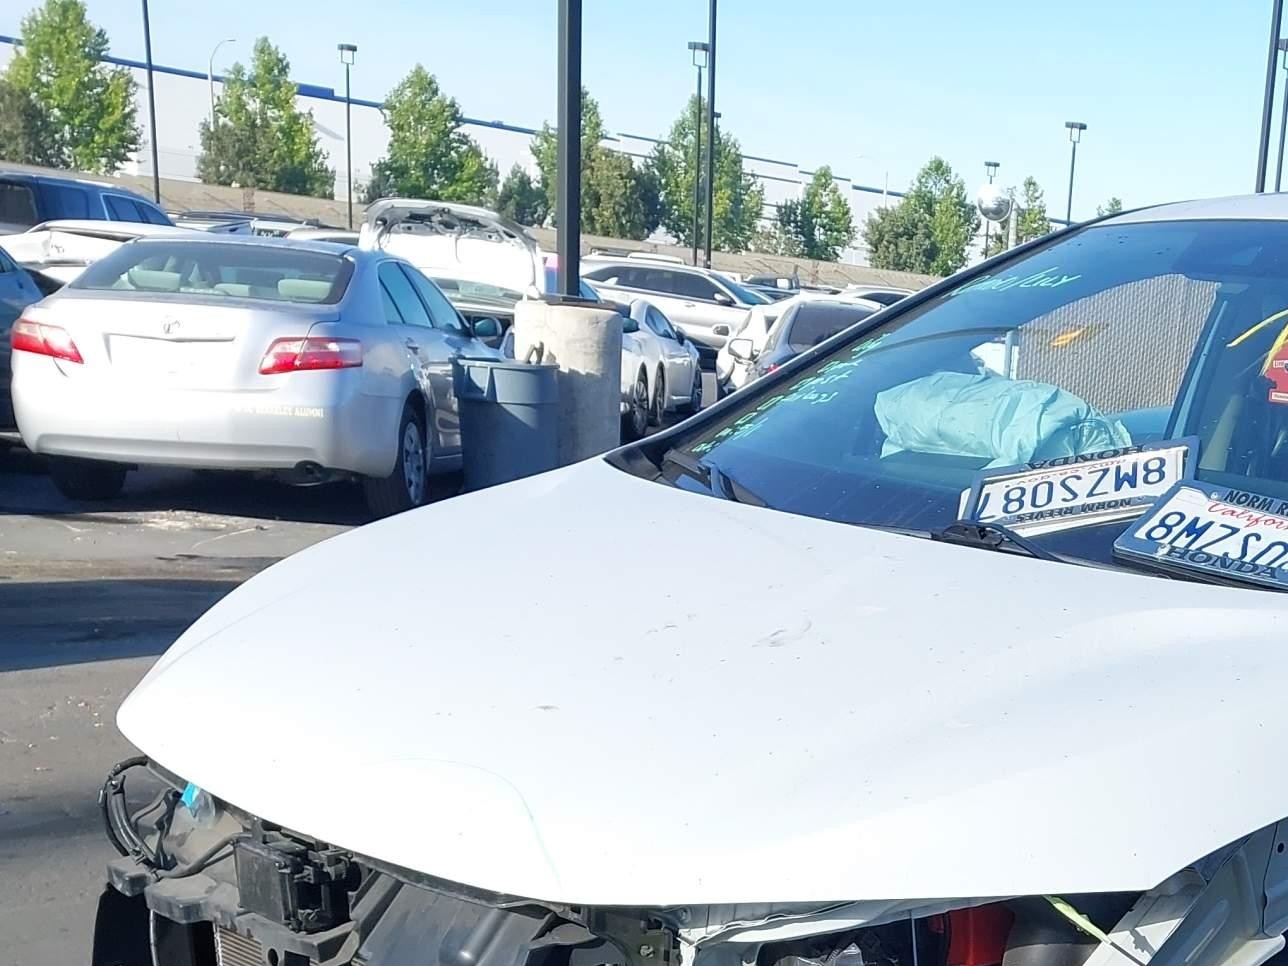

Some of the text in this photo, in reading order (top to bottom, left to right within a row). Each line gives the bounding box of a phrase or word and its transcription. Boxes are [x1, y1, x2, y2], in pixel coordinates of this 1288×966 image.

[1027, 444, 1144, 471] HONDA
[977, 456, 1167, 520] 8MZS087
[1223, 489, 1273, 512] NORM
[1016, 497, 1133, 523] NORM REEVES
[1164, 545, 1281, 580] HONDA
